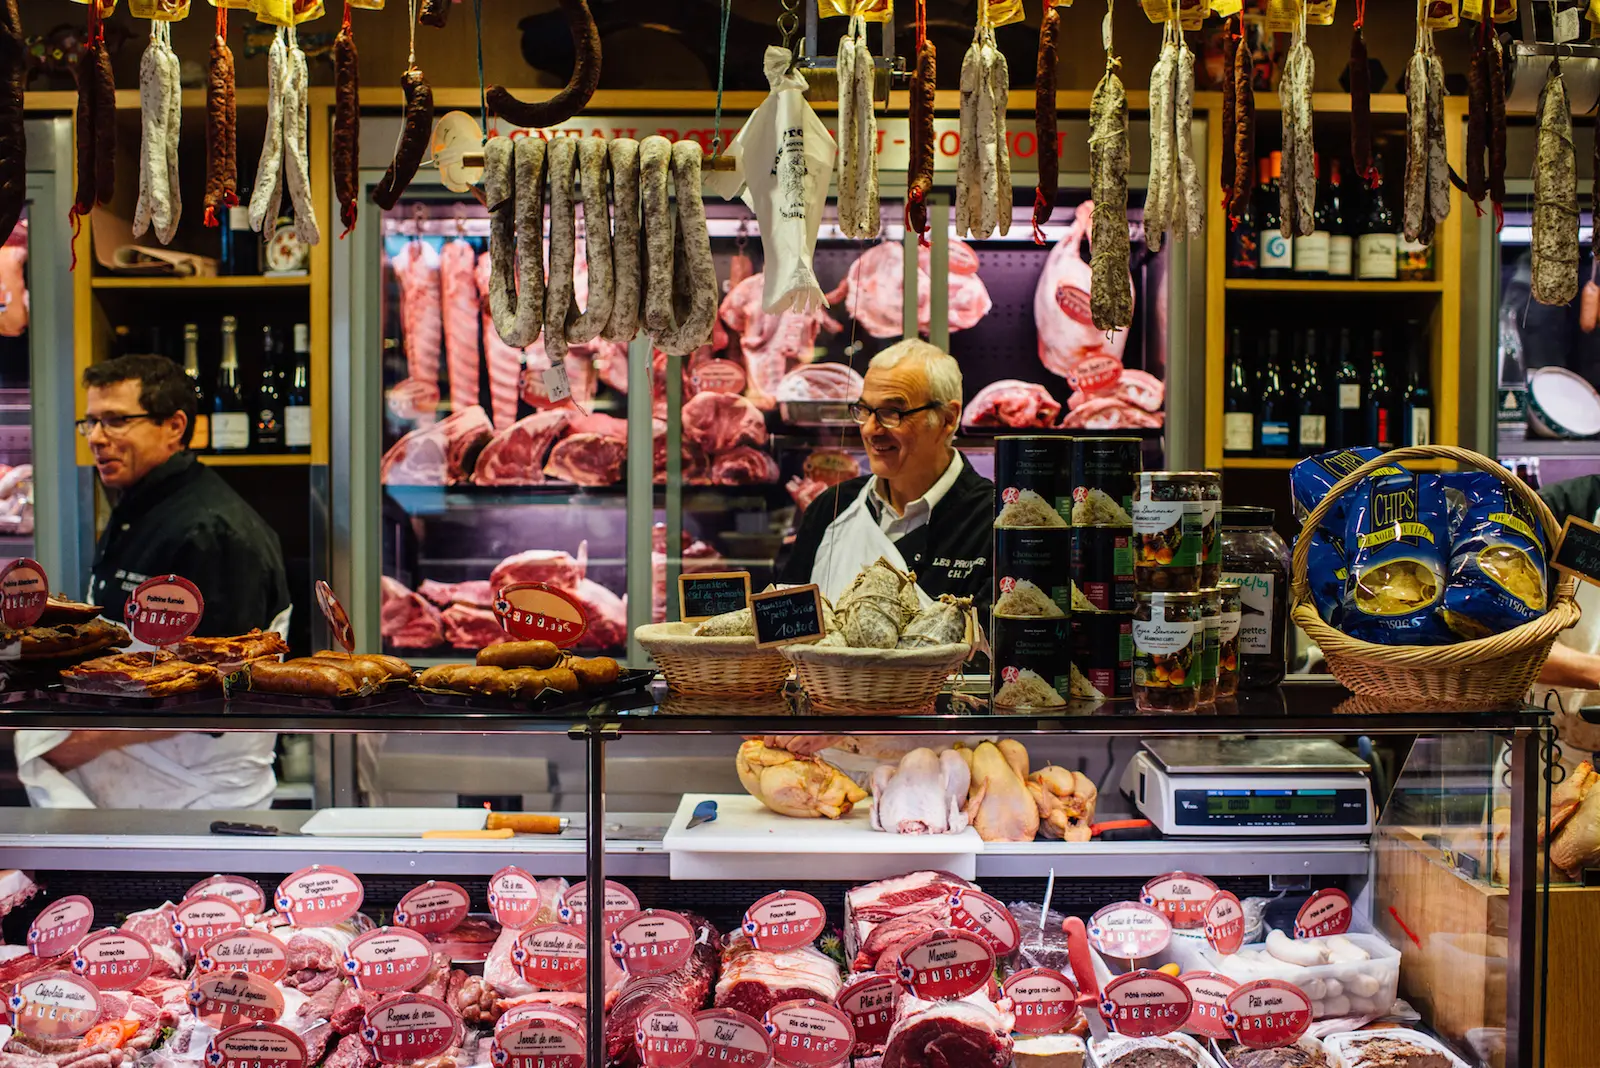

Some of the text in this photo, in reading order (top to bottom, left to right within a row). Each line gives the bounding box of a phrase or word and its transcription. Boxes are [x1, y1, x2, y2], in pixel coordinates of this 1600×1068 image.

[1324, 450, 1364, 478] CHIP
[1374, 488, 1415, 526] CHIPS
[1374, 524, 1431, 543] NOIROUTIER
[99, 949, 125, 957] Entrecôte
[375, 946, 396, 955] Onglet
[1125, 991, 1139, 999] Pâté
[225, 1043, 258, 1052] Paupiette
